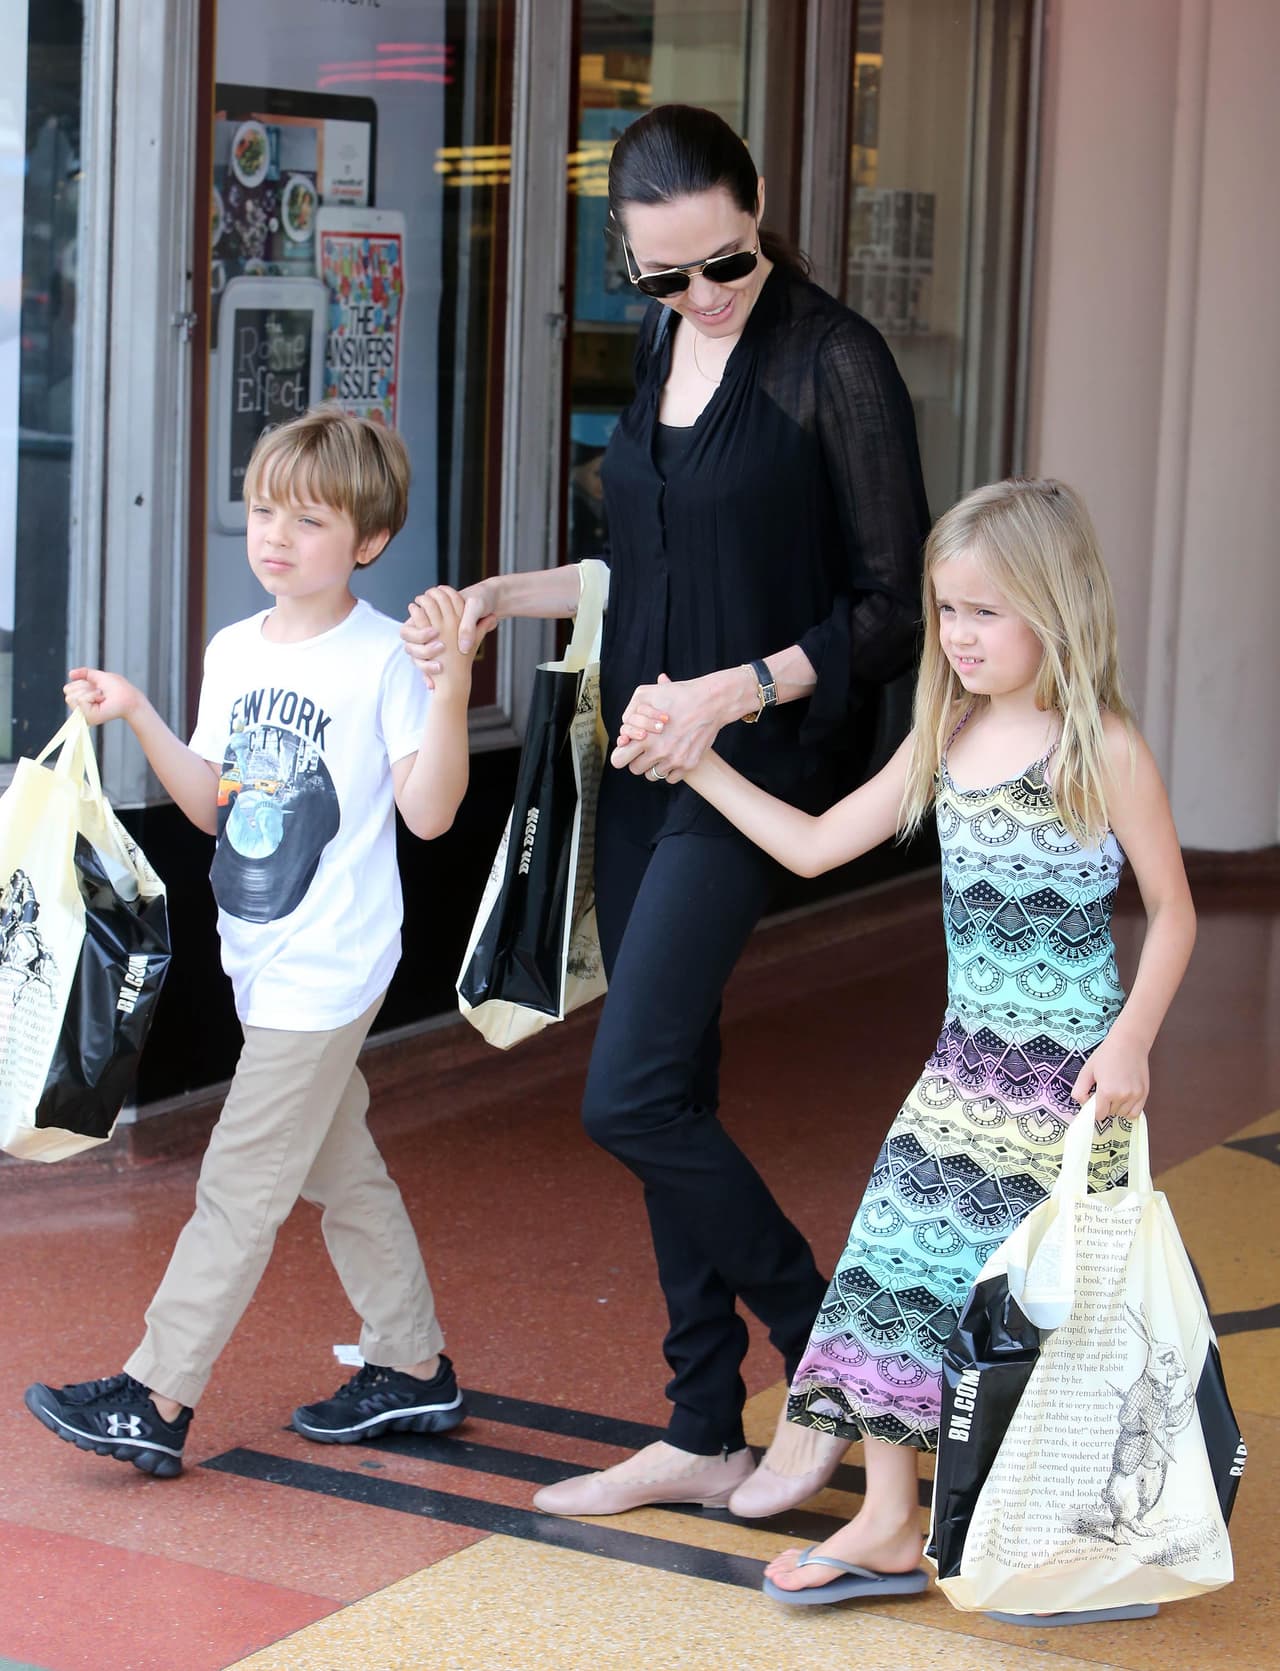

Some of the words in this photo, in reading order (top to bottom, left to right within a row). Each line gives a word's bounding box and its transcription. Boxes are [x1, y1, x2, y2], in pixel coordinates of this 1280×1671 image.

[349, 306, 375, 335] THE
[238, 326, 306, 374] Rosie
[325, 337, 393, 367] ANSWERS
[338, 368, 379, 399] ISSUE
[236, 365, 305, 417] Effect
[1085, 1213, 1093, 1223] by
[1095, 1215, 1108, 1224] her
[1111, 1217, 1132, 1225] sister
[1087, 1225, 1114, 1237] having
[1086, 1239, 1108, 1248] twice
[1083, 1301, 1096, 1310] her
[1070, 1313, 1082, 1321] the
[1114, 1327, 1127, 1335] the
[1087, 1351, 1100, 1360] and
[1101, 1352, 1128, 1361] picking
[1077, 1363, 1098, 1372] White
[1099, 1364, 1124, 1372] Rabbit
[948, 1369, 981, 1442] BN.COM
[1041, 1448, 1061, 1457] have
[1062, 1451, 1100, 1460] wondered
[1040, 1462, 1068, 1471] seemed
[1070, 1464, 1091, 1473] quite
[1043, 1475, 1074, 1485] actually
[1060, 1489, 1075, 1497] and
[1044, 1501, 1066, 1509] Alice
[1031, 1549, 1050, 1557] with
[1012, 1560, 1033, 1569] after
